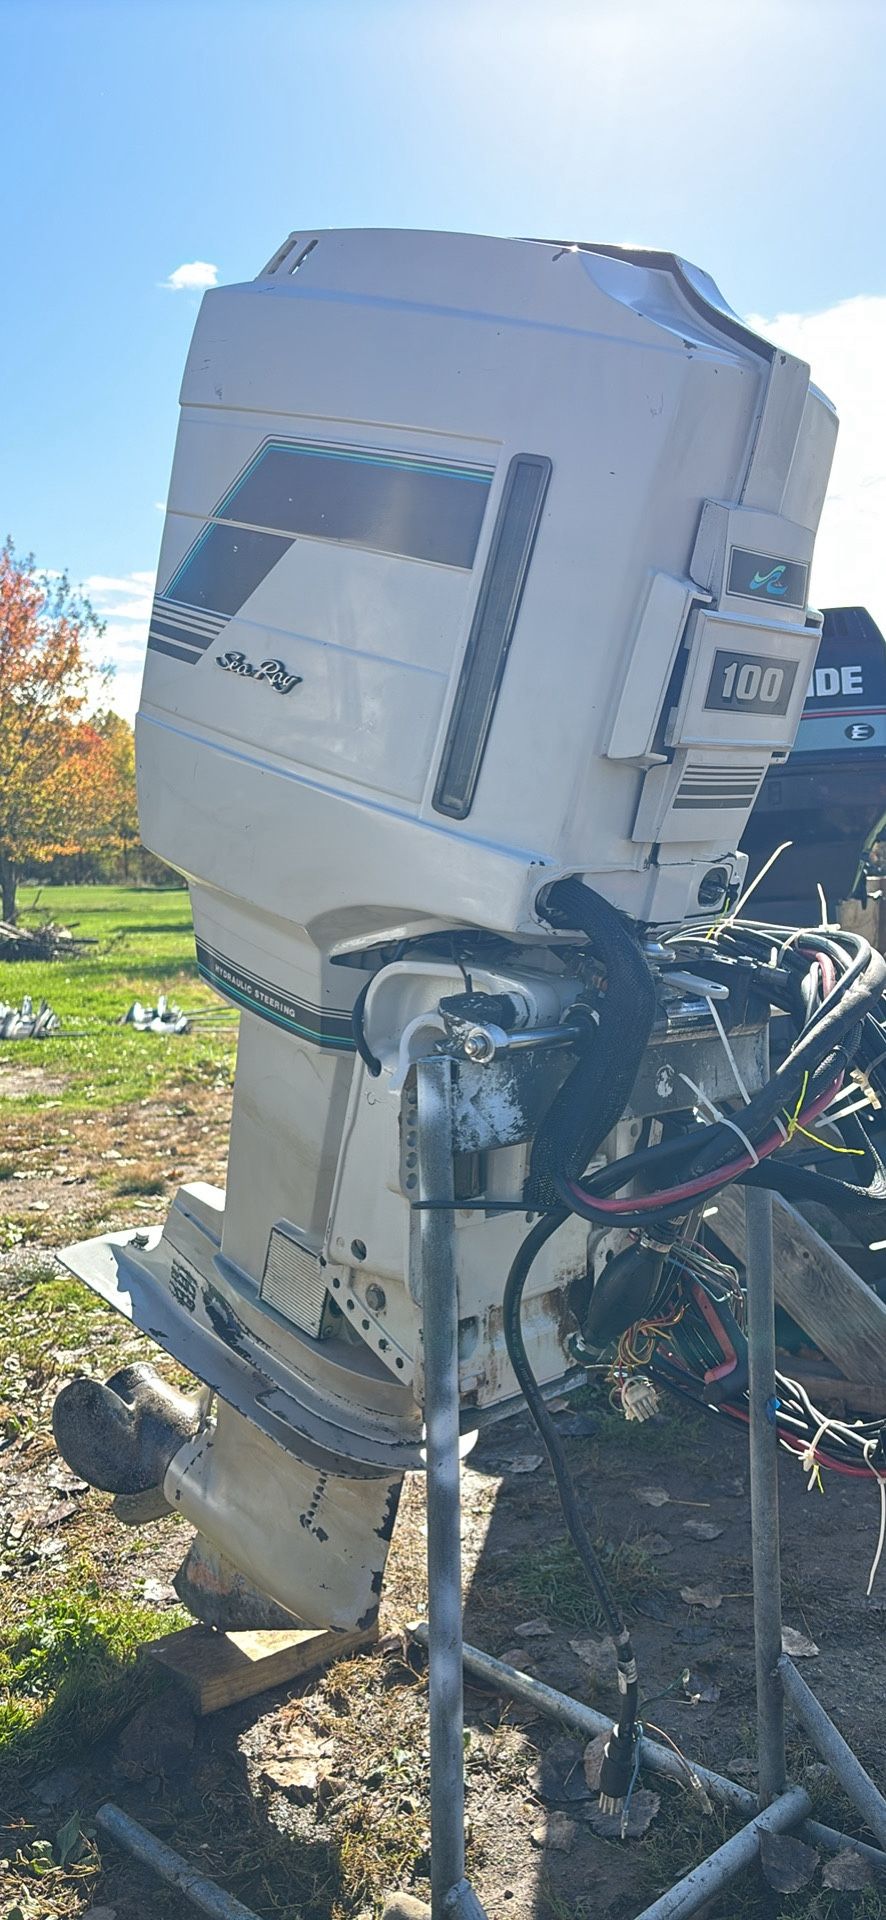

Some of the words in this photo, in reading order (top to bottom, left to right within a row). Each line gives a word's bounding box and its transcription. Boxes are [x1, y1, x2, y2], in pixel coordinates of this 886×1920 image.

[215, 651, 251, 676] Sea
[253, 659, 303, 695] Ray
[721, 662, 784, 702] 100
[214, 964, 253, 994] HYDRAULIC
[254, 989, 296, 1018] STEERING
